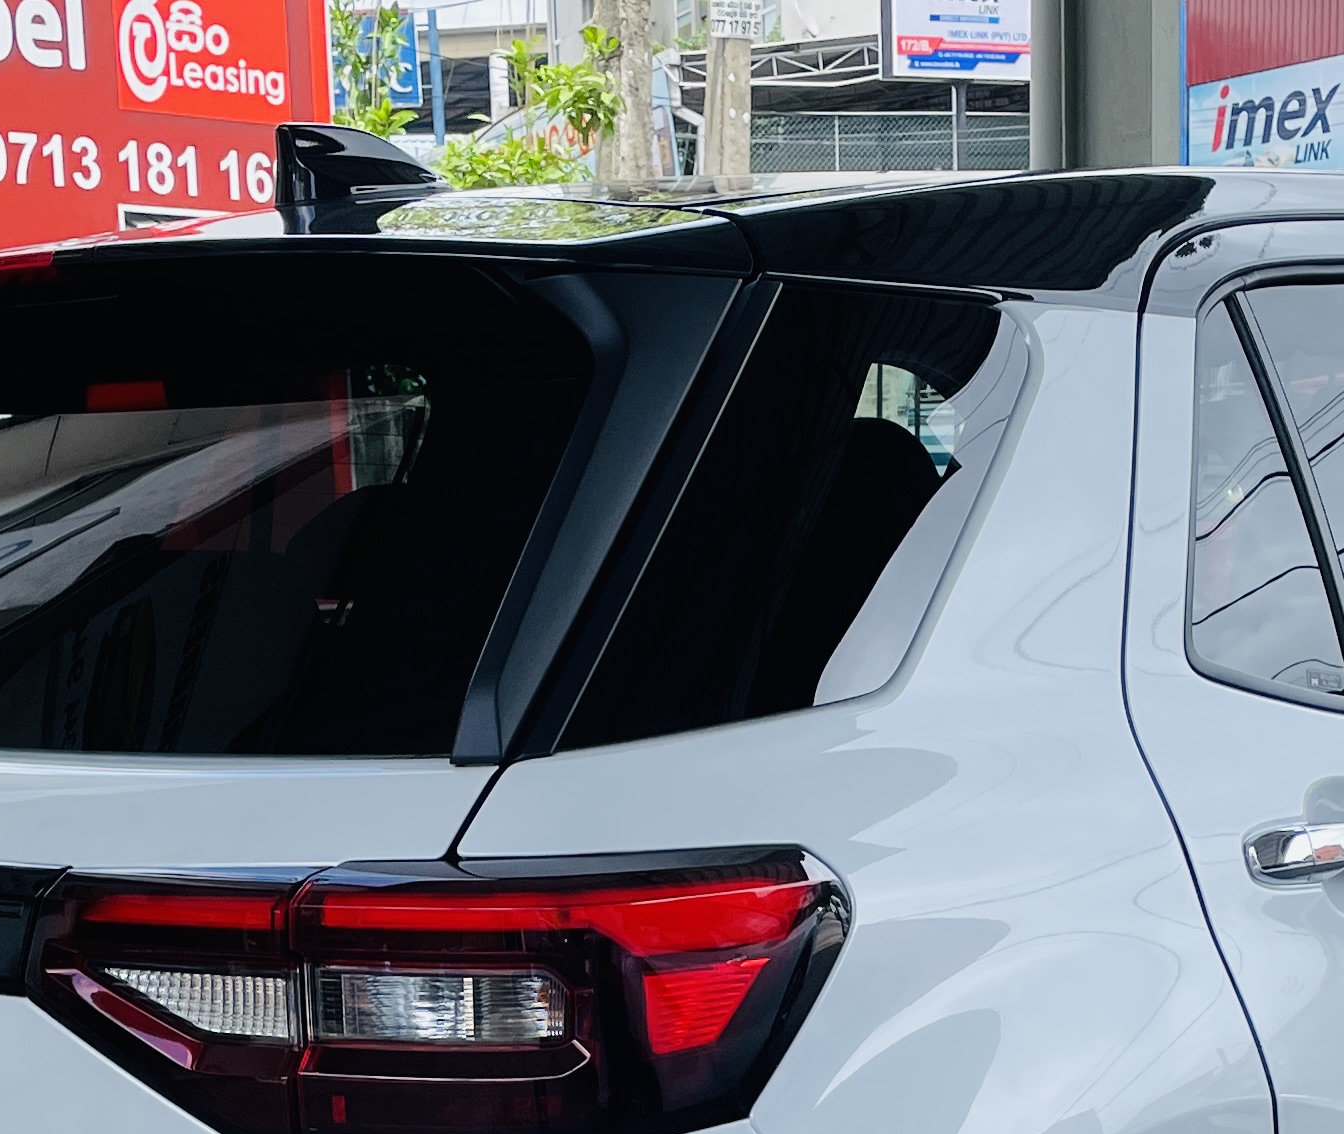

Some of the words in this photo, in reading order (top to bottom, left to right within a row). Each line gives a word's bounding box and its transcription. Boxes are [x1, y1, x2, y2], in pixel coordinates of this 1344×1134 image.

[970, 31, 989, 39] LINK
[991, 32, 1011, 42] (PVT)
[1013, 33, 1029, 42] LTD
[168, 52, 287, 106] Leasing
[1211, 83, 1342, 153] imex
[118, 139, 199, 197] 181
[219, 149, 278, 204] 16
[1294, 139, 1333, 165] LINK
